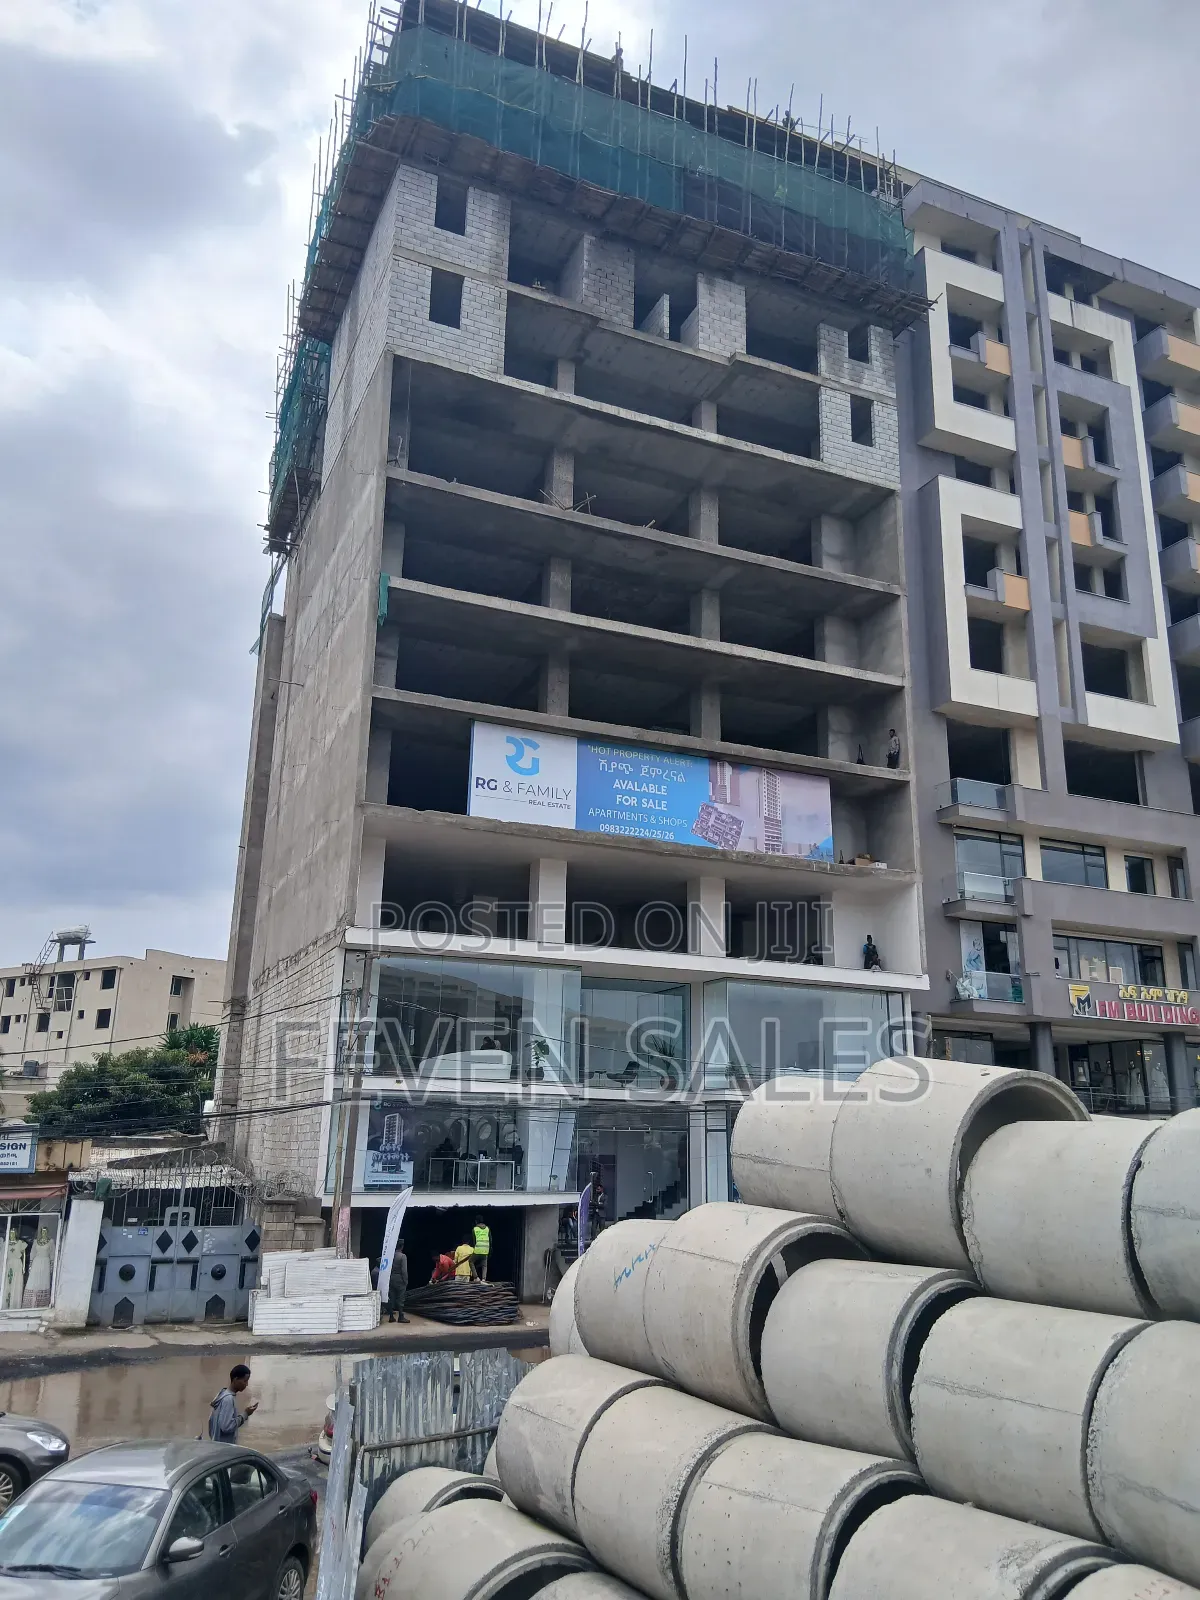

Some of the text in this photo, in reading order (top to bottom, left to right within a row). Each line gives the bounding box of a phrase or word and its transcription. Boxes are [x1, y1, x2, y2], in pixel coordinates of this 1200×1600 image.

[613, 748, 661, 763] PROPERTY
[475, 776, 572, 801] RG & FAMILY
[612, 779, 668, 796] AVALABLE
[528, 799, 572, 810] REAL ESTATE
[616, 794, 668, 811] FOR SALE
[587, 807, 688, 828] APARTMENTS & SHOPS
[599, 823, 675, 840] 0983222224/25/26
[1095, 999, 1200, 1026] FM BUILDING
